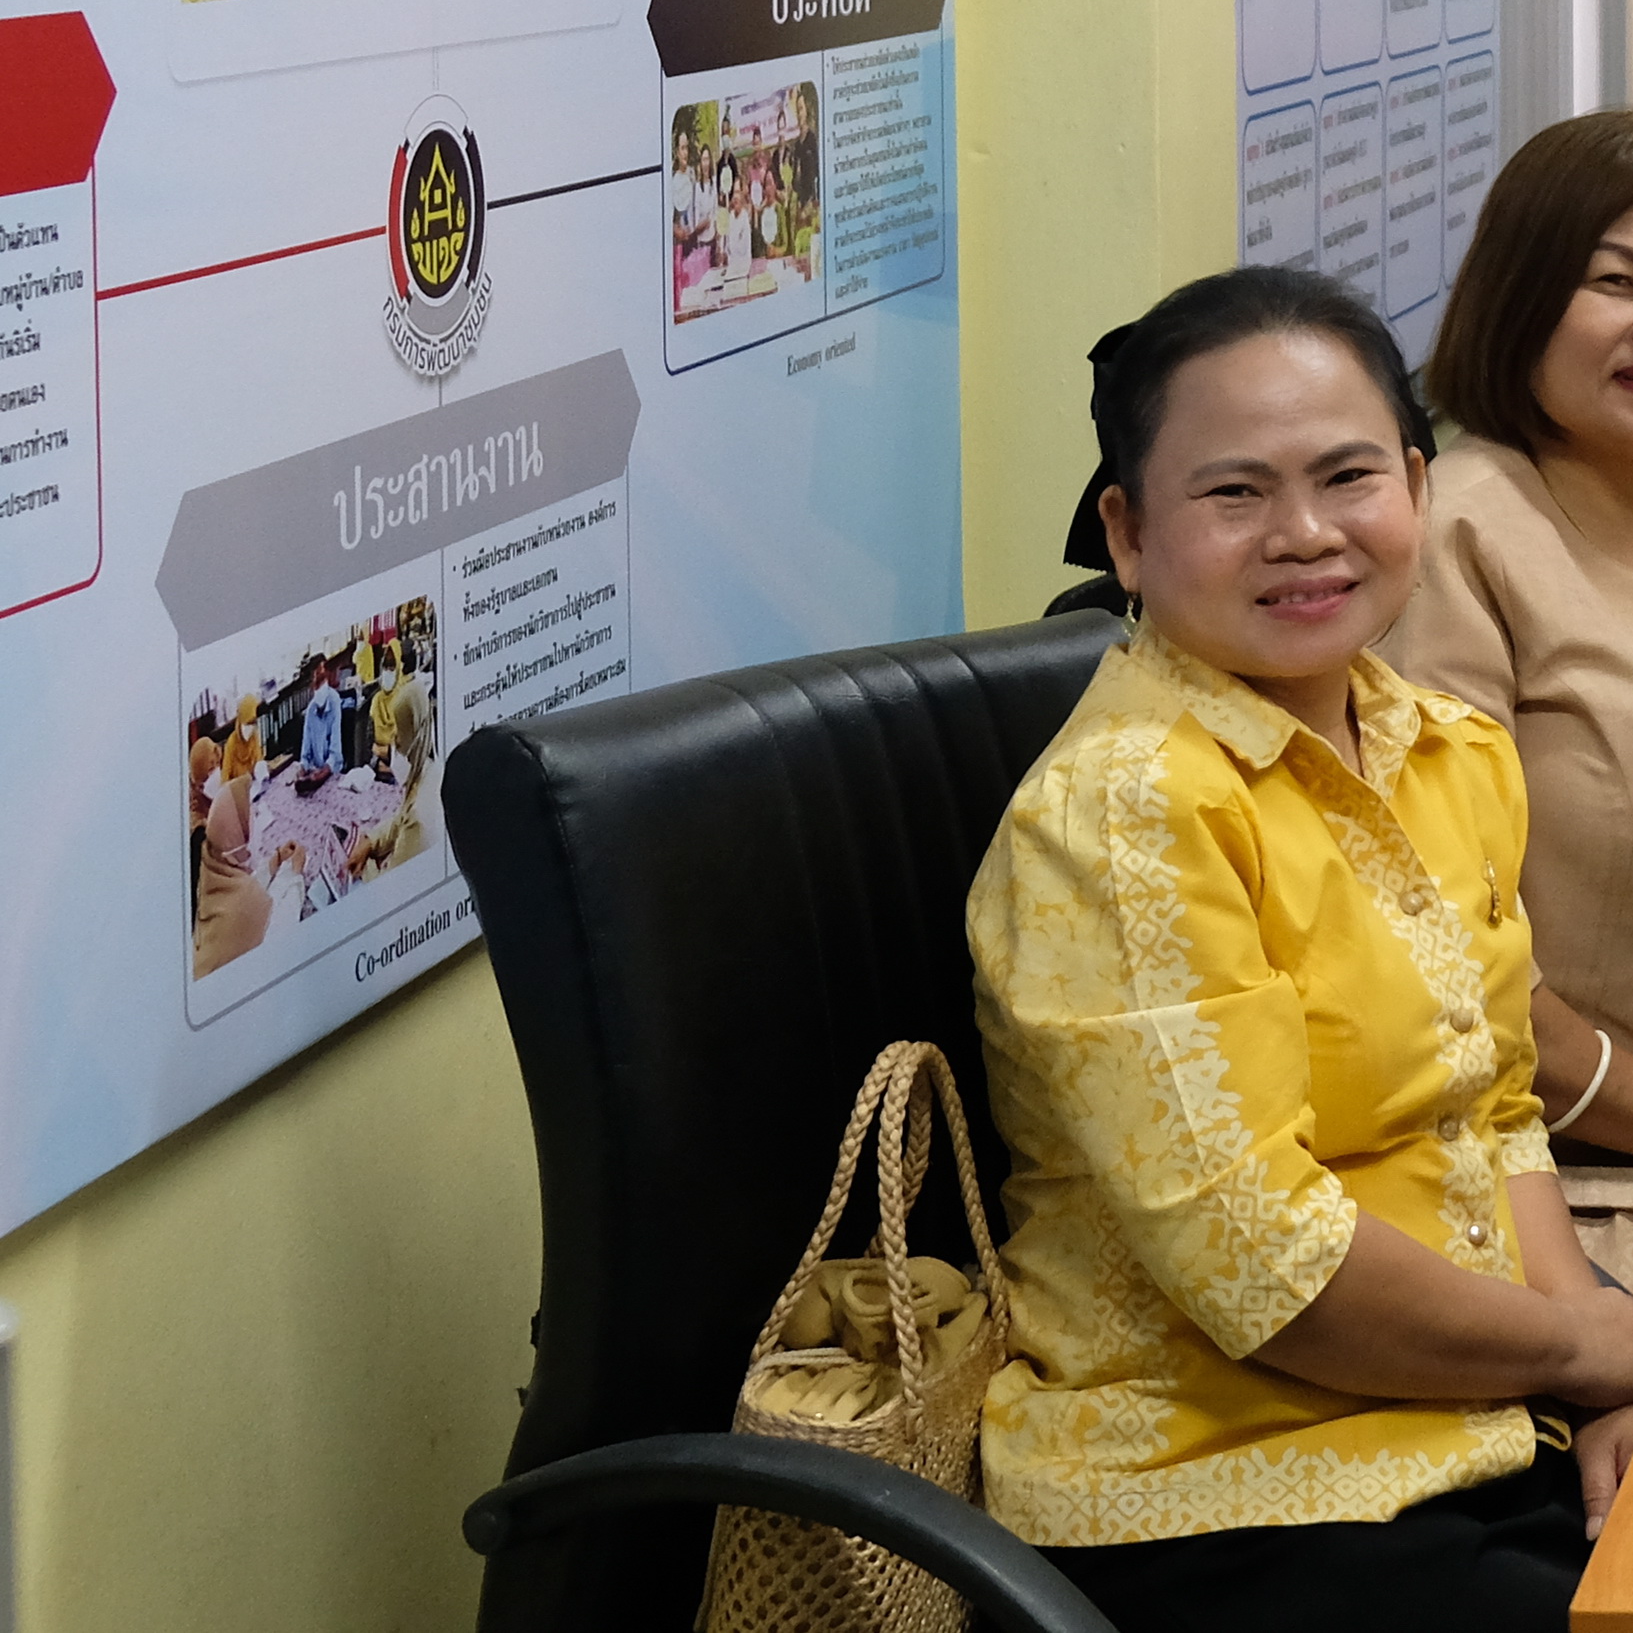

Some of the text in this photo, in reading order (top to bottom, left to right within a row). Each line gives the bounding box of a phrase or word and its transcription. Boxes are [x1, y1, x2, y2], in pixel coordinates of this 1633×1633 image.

[334, 420, 544, 550] ประสานงาน
[355, 908, 451, 983] Co-ordination
